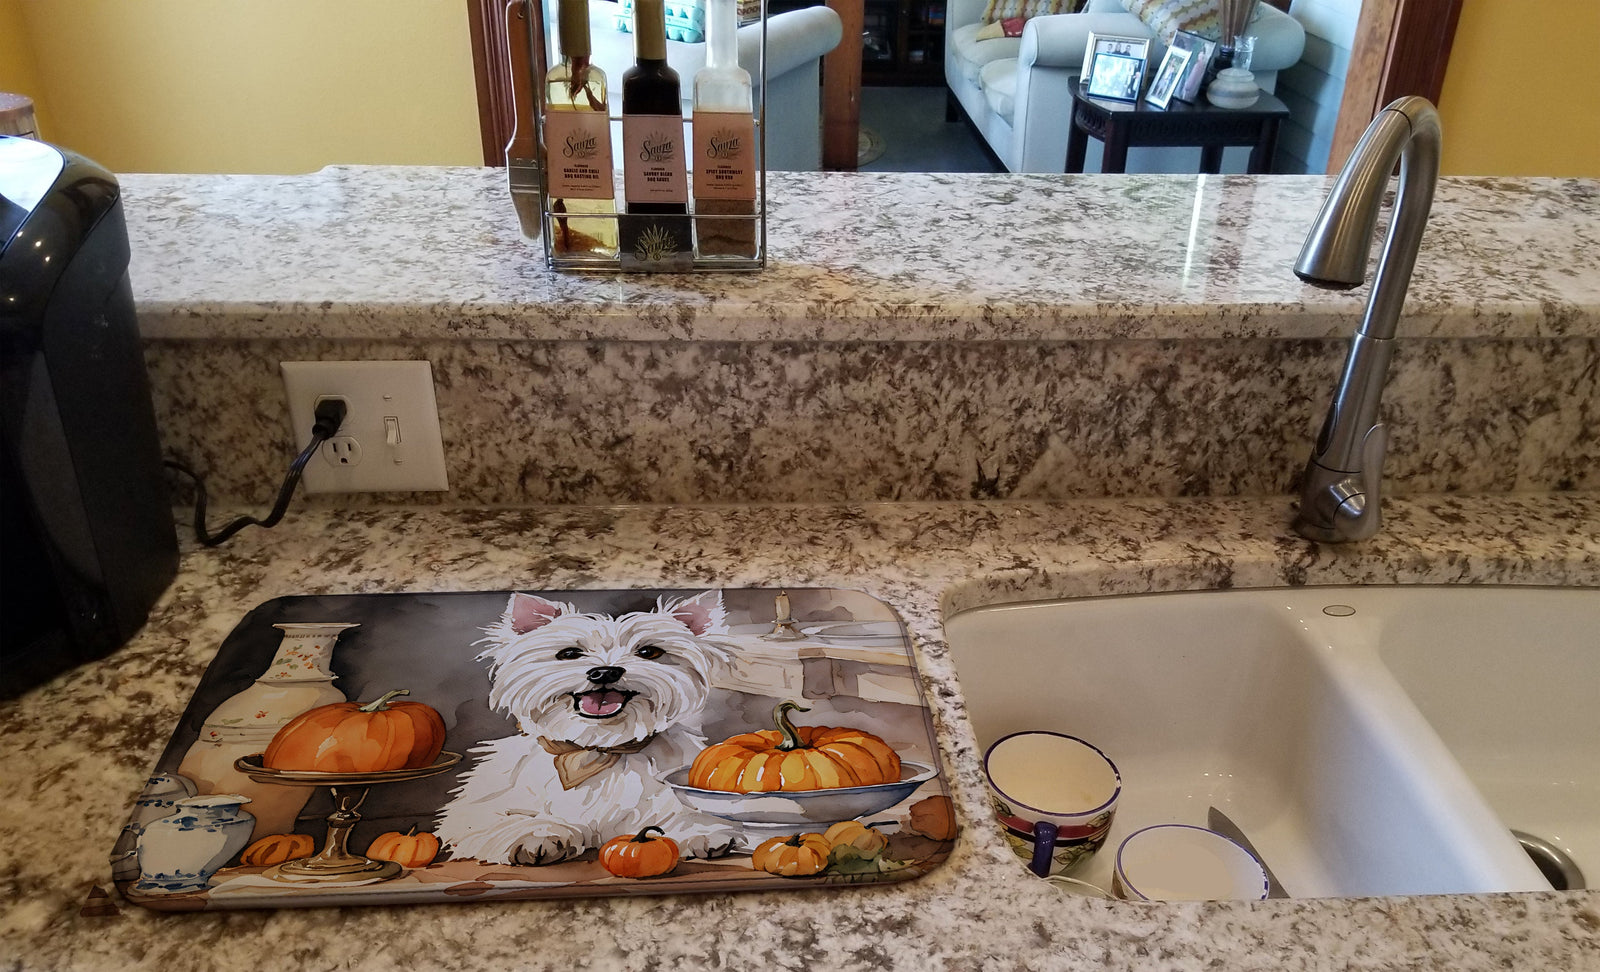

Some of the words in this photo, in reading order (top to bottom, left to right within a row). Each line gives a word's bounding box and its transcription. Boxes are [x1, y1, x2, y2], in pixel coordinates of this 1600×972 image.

[562, 136, 597, 158] Sauza
[640, 140, 673, 161] Sauza
[707, 137, 740, 158] Sauza
